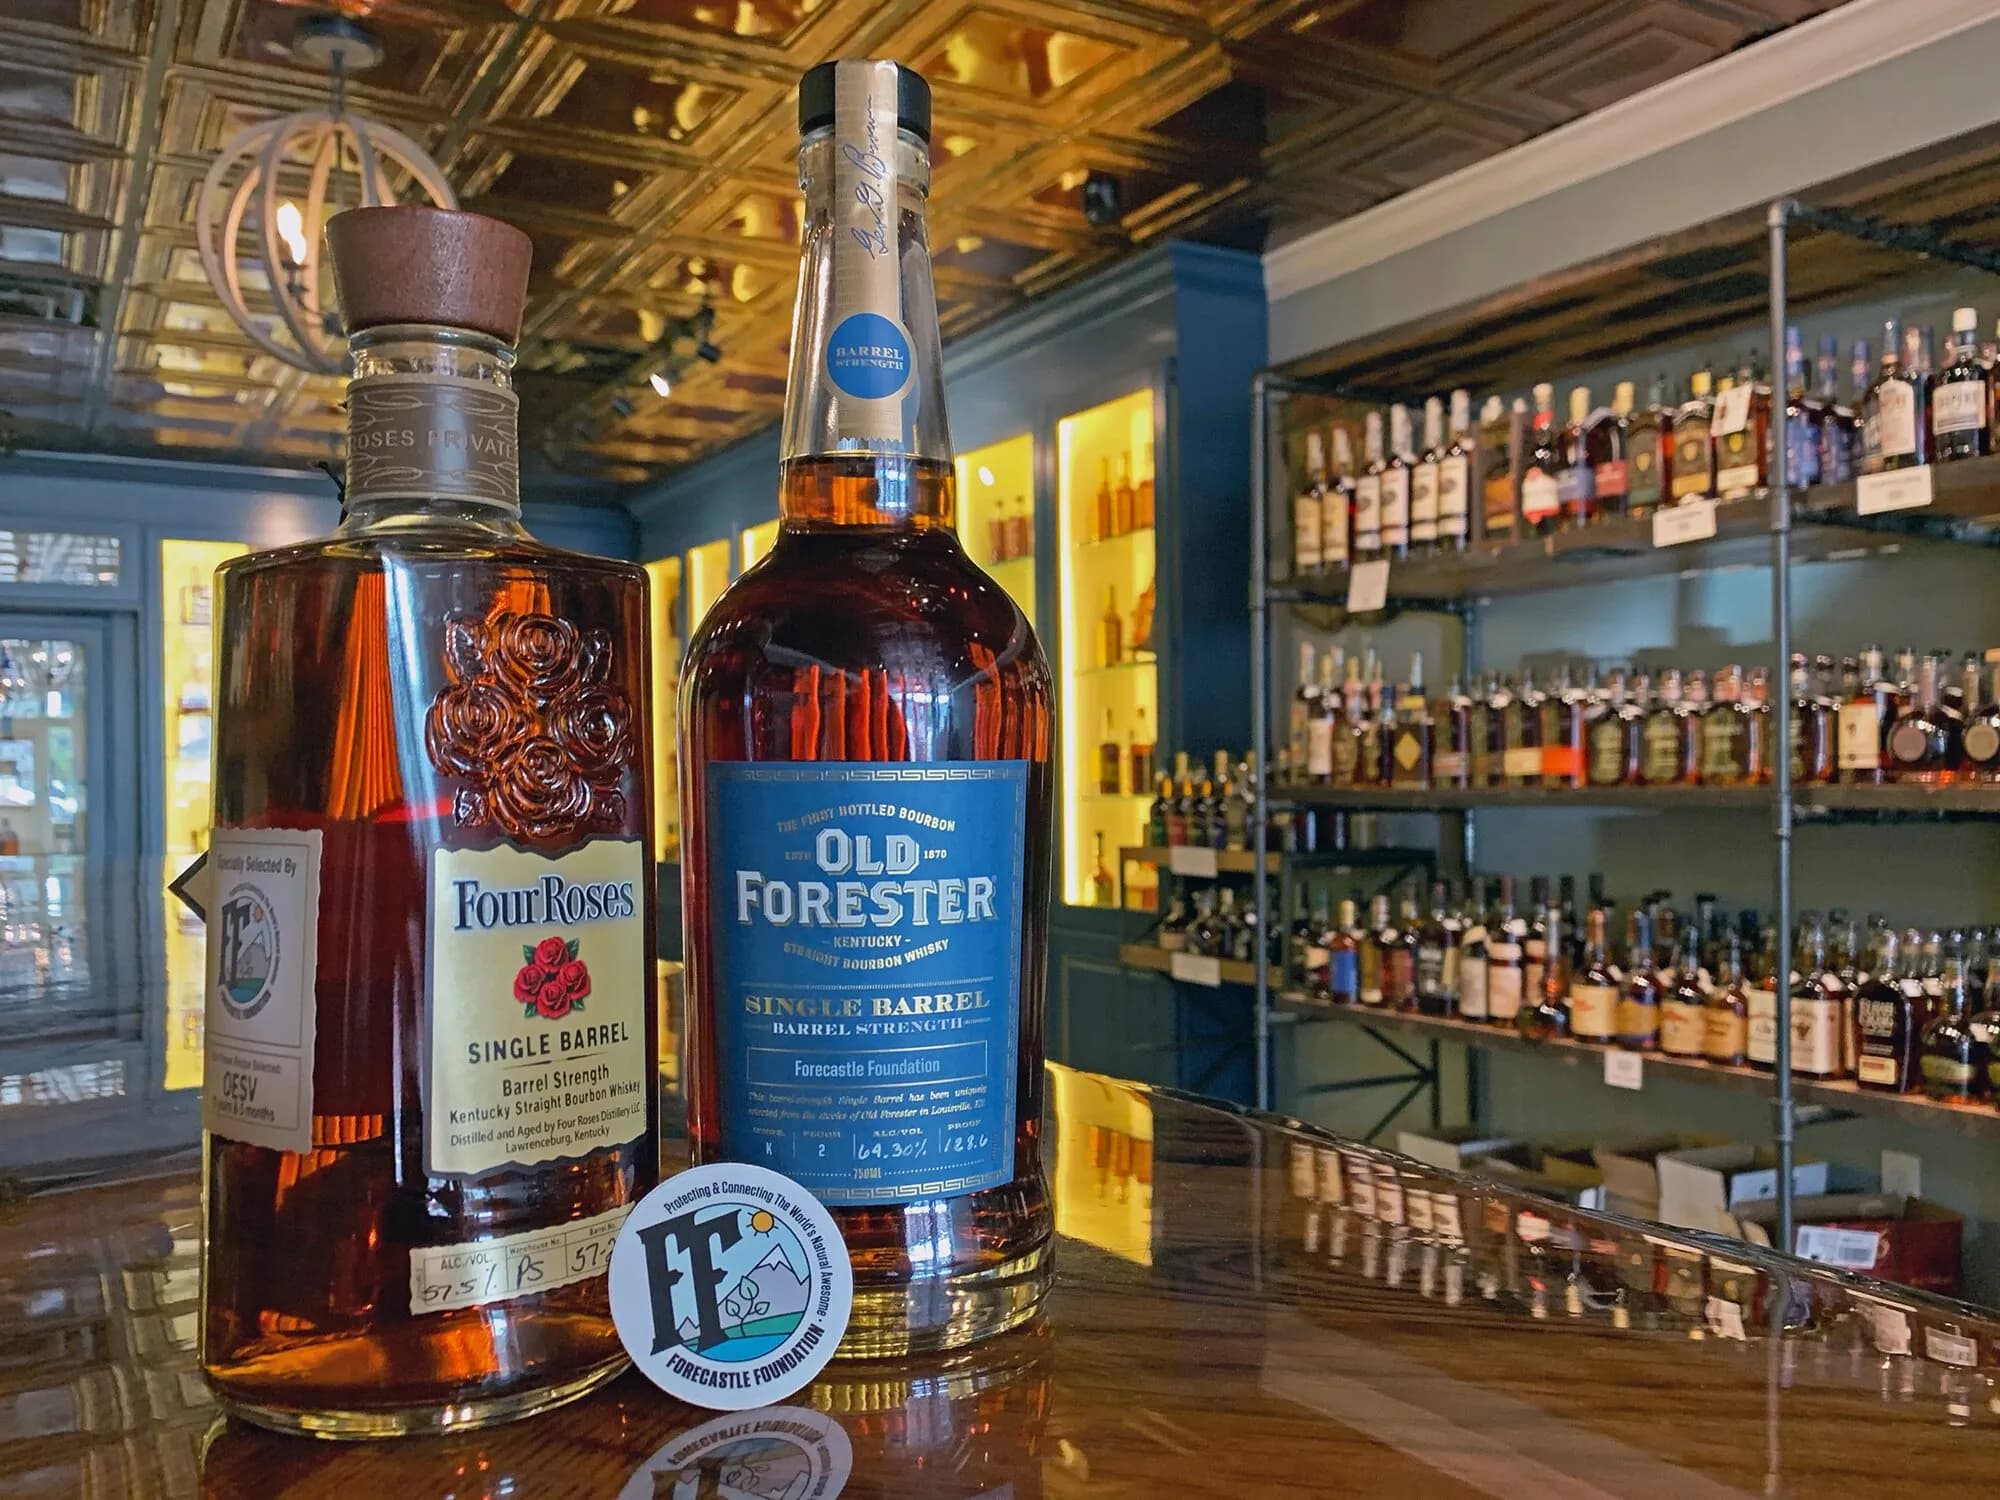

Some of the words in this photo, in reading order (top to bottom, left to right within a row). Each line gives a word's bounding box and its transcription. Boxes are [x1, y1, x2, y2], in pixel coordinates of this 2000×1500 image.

[835, 358, 904, 370] STRENGTH
[836, 346, 904, 361] BARREL
[776, 820, 799, 834] THE
[839, 803, 896, 817] BOTTLED
[899, 806, 956, 832] BOURBON
[246, 855, 282, 874] Selected
[284, 857, 297, 878] By
[816, 828, 920, 876] OLD
[923, 848, 948, 860] 1870
[453, 879, 540, 931] Four
[539, 874, 635, 926] Roses
[736, 869, 999, 928] FORESTER
[784, 941, 842, 968] STRAIGHT
[843, 954, 903, 971] BOURBON
[903, 938, 950, 964] WHISKY
[833, 935, 903, 948] KENTUCKY
[745, 994, 863, 1017] SINGLE
[872, 990, 991, 1016] BARREL
[772, 1021, 851, 1036] BARREL
[855, 1016, 964, 1035] STRENGTH
[468, 1033, 551, 1065] SINGLE
[560, 1020, 630, 1052] BARREL
[502, 1073, 549, 1098] Barrel
[553, 1063, 610, 1090] Strength
[794, 1059, 865, 1078] Forecastle
[867, 1058, 941, 1077] Foundation
[450, 1103, 511, 1125] Kentucky
[515, 1095, 562, 1118] Straight
[564, 1089, 608, 1107] Bourbon
[608, 1079, 641, 1099] Whiskey
[929, 1090, 950, 1101] been
[450, 1130, 494, 1147] Distilled
[496, 1126, 515, 1141] and
[517, 1121, 542, 1141] Aged
[543, 1121, 556, 1138] by
[557, 1117, 576, 1130] Four
[577, 1113, 601, 1127] Roses
[600, 1104, 631, 1122] Distillery
[630, 1101, 642, 1114] LLC
[879, 1107, 918, 1119] Forester
[505, 1132, 573, 1154] Lawrenceburg,
[574, 1124, 611, 1142] Kentucky
[818, 1143, 826, 1157] 2
[663, 1182, 712, 1215] Protecting
[712, 1181, 721, 1195] &
[721, 1180, 774, 1204] Connecting
[774, 1192, 791, 1212] The
[788, 1204, 817, 1239] World's
[809, 1234, 830, 1270] Natural
[816, 1265, 834, 1317] Awesome
[666, 1352, 752, 1390] FORECASTLE
[752, 1322, 826, 1386] FOUNDATION
